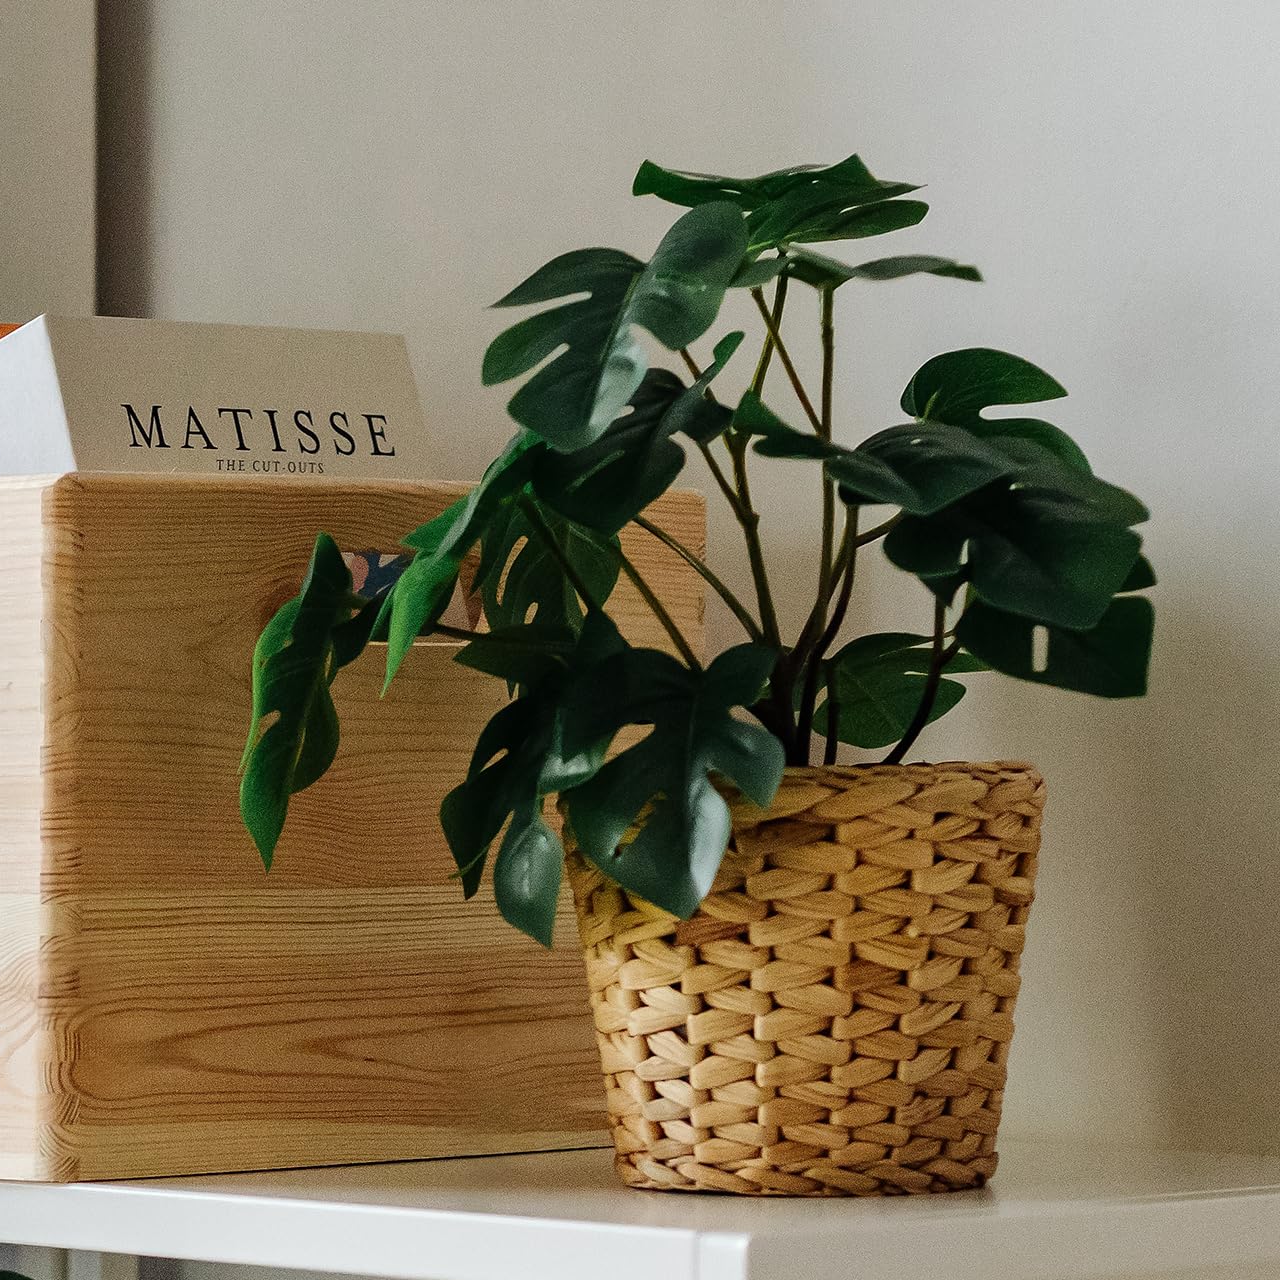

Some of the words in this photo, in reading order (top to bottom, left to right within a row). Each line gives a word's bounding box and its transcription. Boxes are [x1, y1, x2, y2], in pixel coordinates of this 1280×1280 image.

[120, 403, 396, 457] MATISSE
[216, 459, 246, 472] THE
[252, 460, 325, 475] CUT-OUTS
